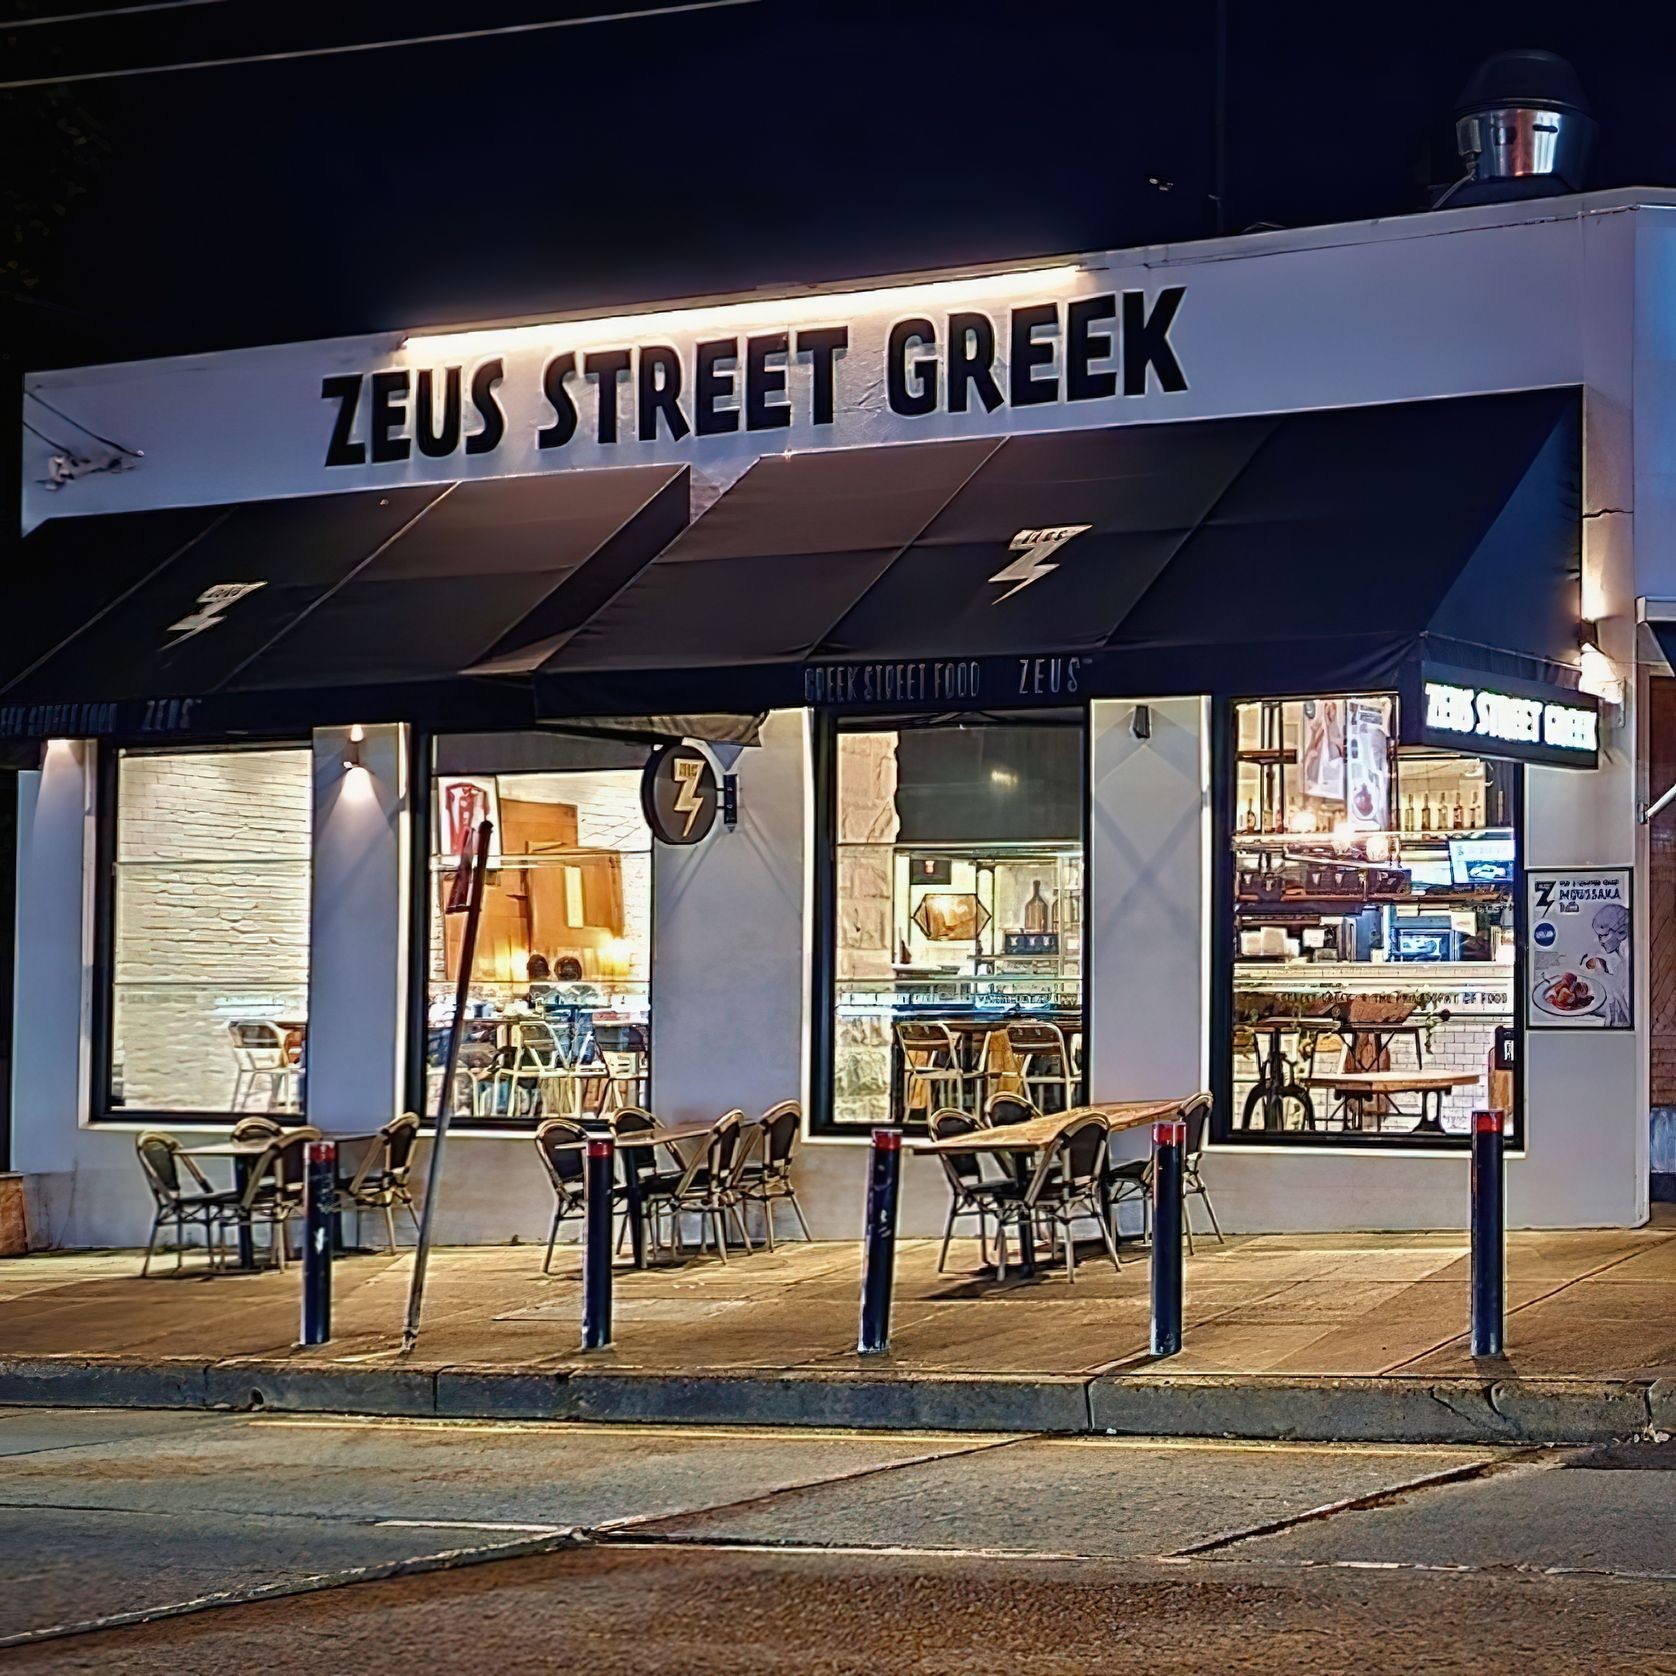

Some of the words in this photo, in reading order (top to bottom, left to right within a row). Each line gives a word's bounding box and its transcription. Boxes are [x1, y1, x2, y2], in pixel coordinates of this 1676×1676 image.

[322, 361, 504, 468] ZEUS
[538, 326, 849, 450] STREET
[887, 286, 1188, 417] GREEK
[863, 663, 927, 700] STREET
[934, 661, 981, 699] FOOD
[1019, 656, 1081, 695] ZEUS
